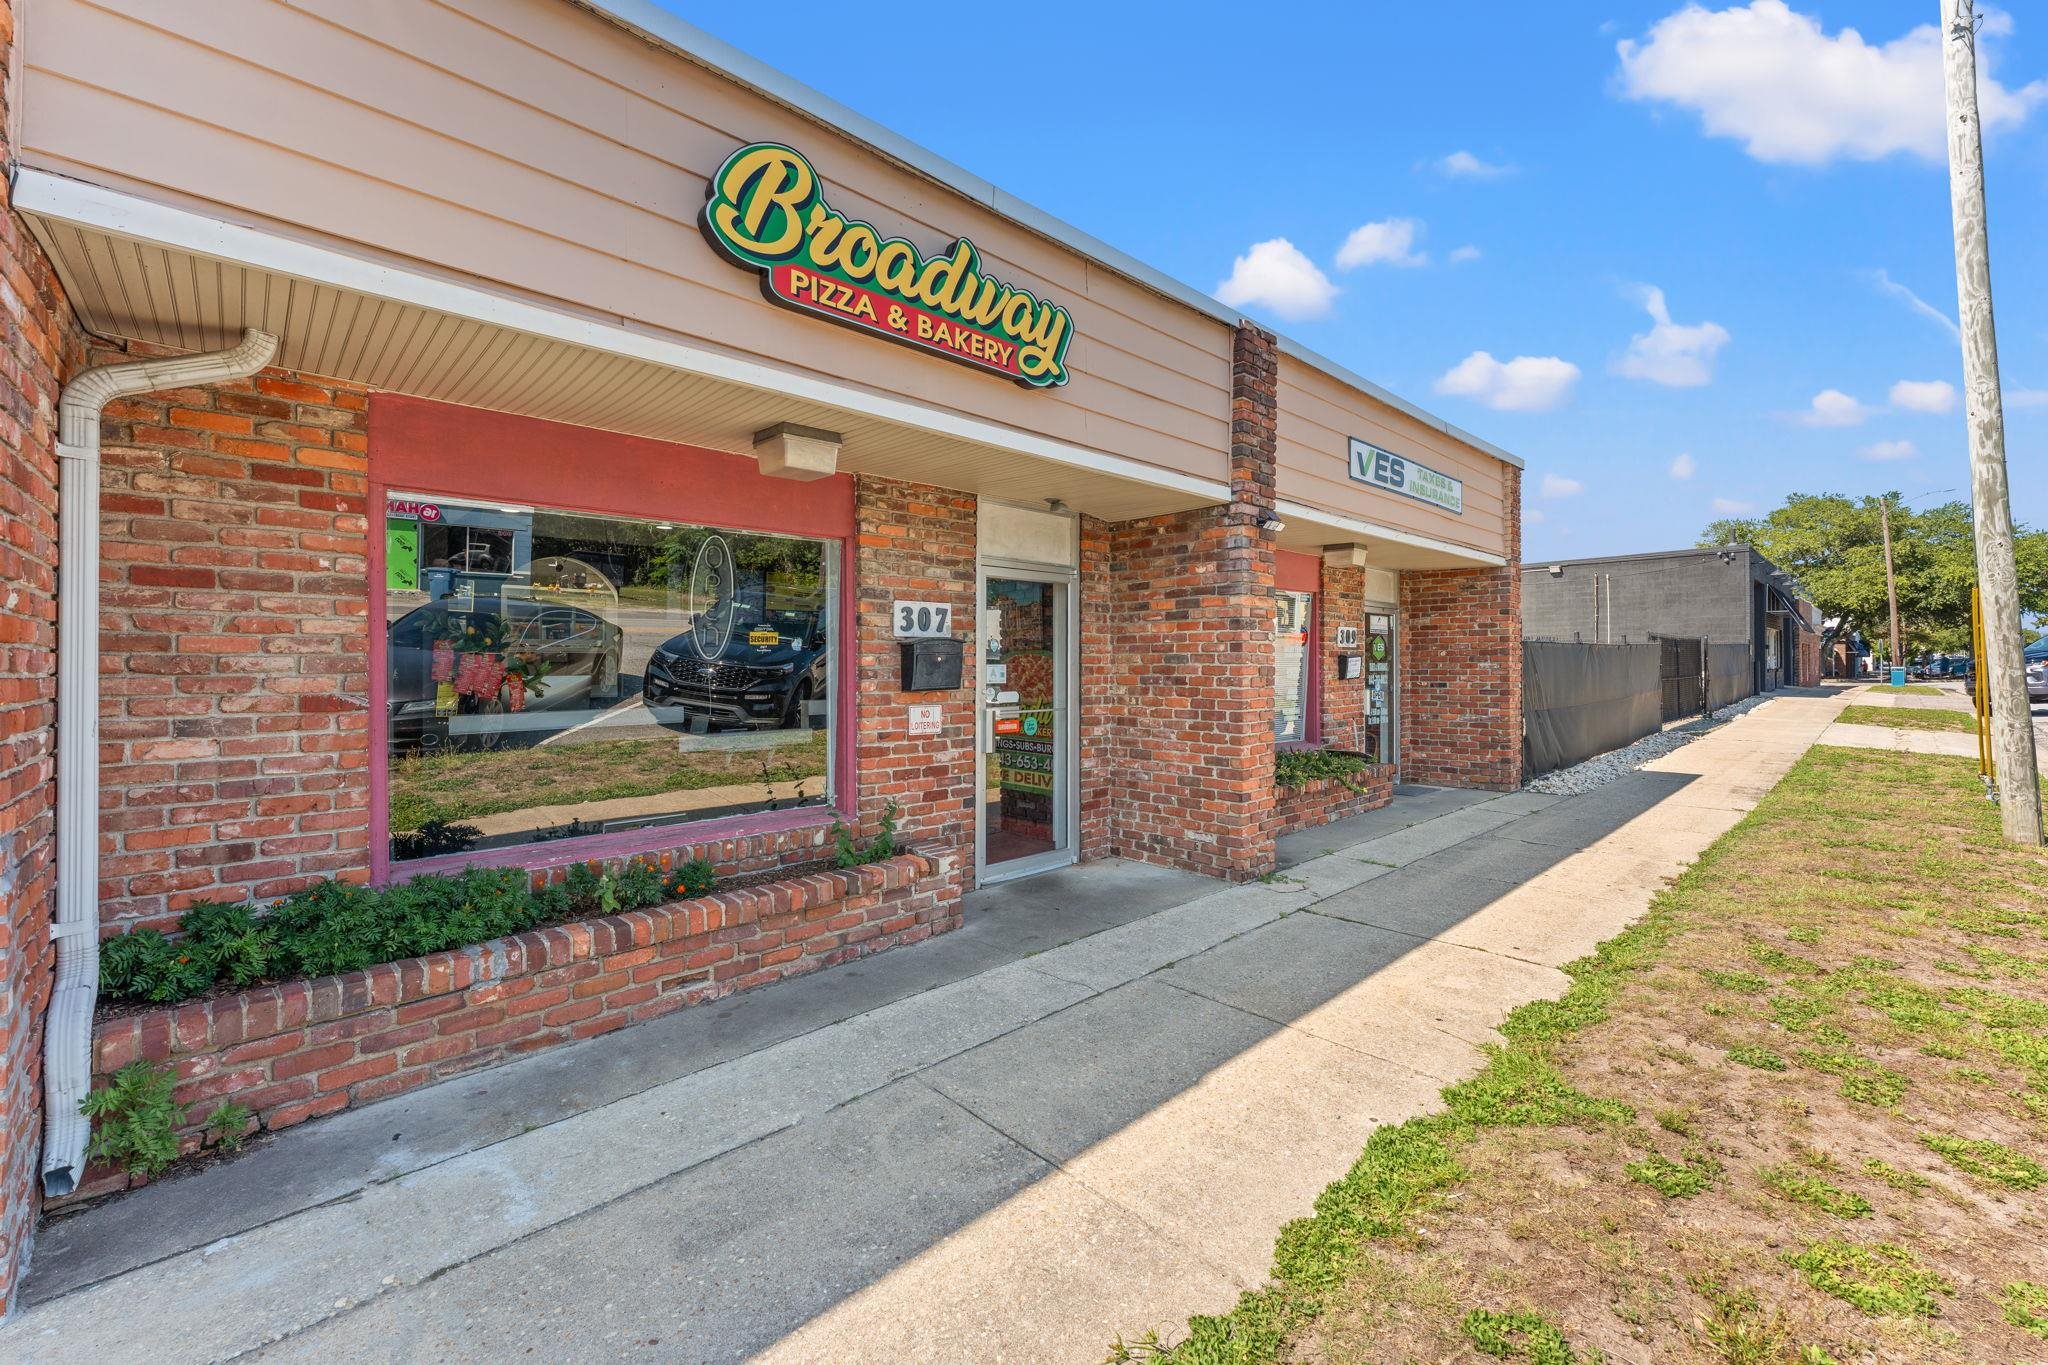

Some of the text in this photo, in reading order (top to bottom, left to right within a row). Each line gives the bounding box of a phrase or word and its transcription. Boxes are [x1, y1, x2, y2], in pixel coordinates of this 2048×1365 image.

[714, 148, 1066, 377] Broadway
[790, 268, 1015, 368] PIZZA & BAKERY
[1356, 448, 1405, 488] VES
[1416, 468, 1446, 489] TAXES
[1409, 479, 1461, 509] INSURANCE
[899, 606, 949, 633] 307
[750, 635, 778, 643] SECURITY
[1340, 629, 1357, 645] 309
[920, 710, 931, 719] NO
